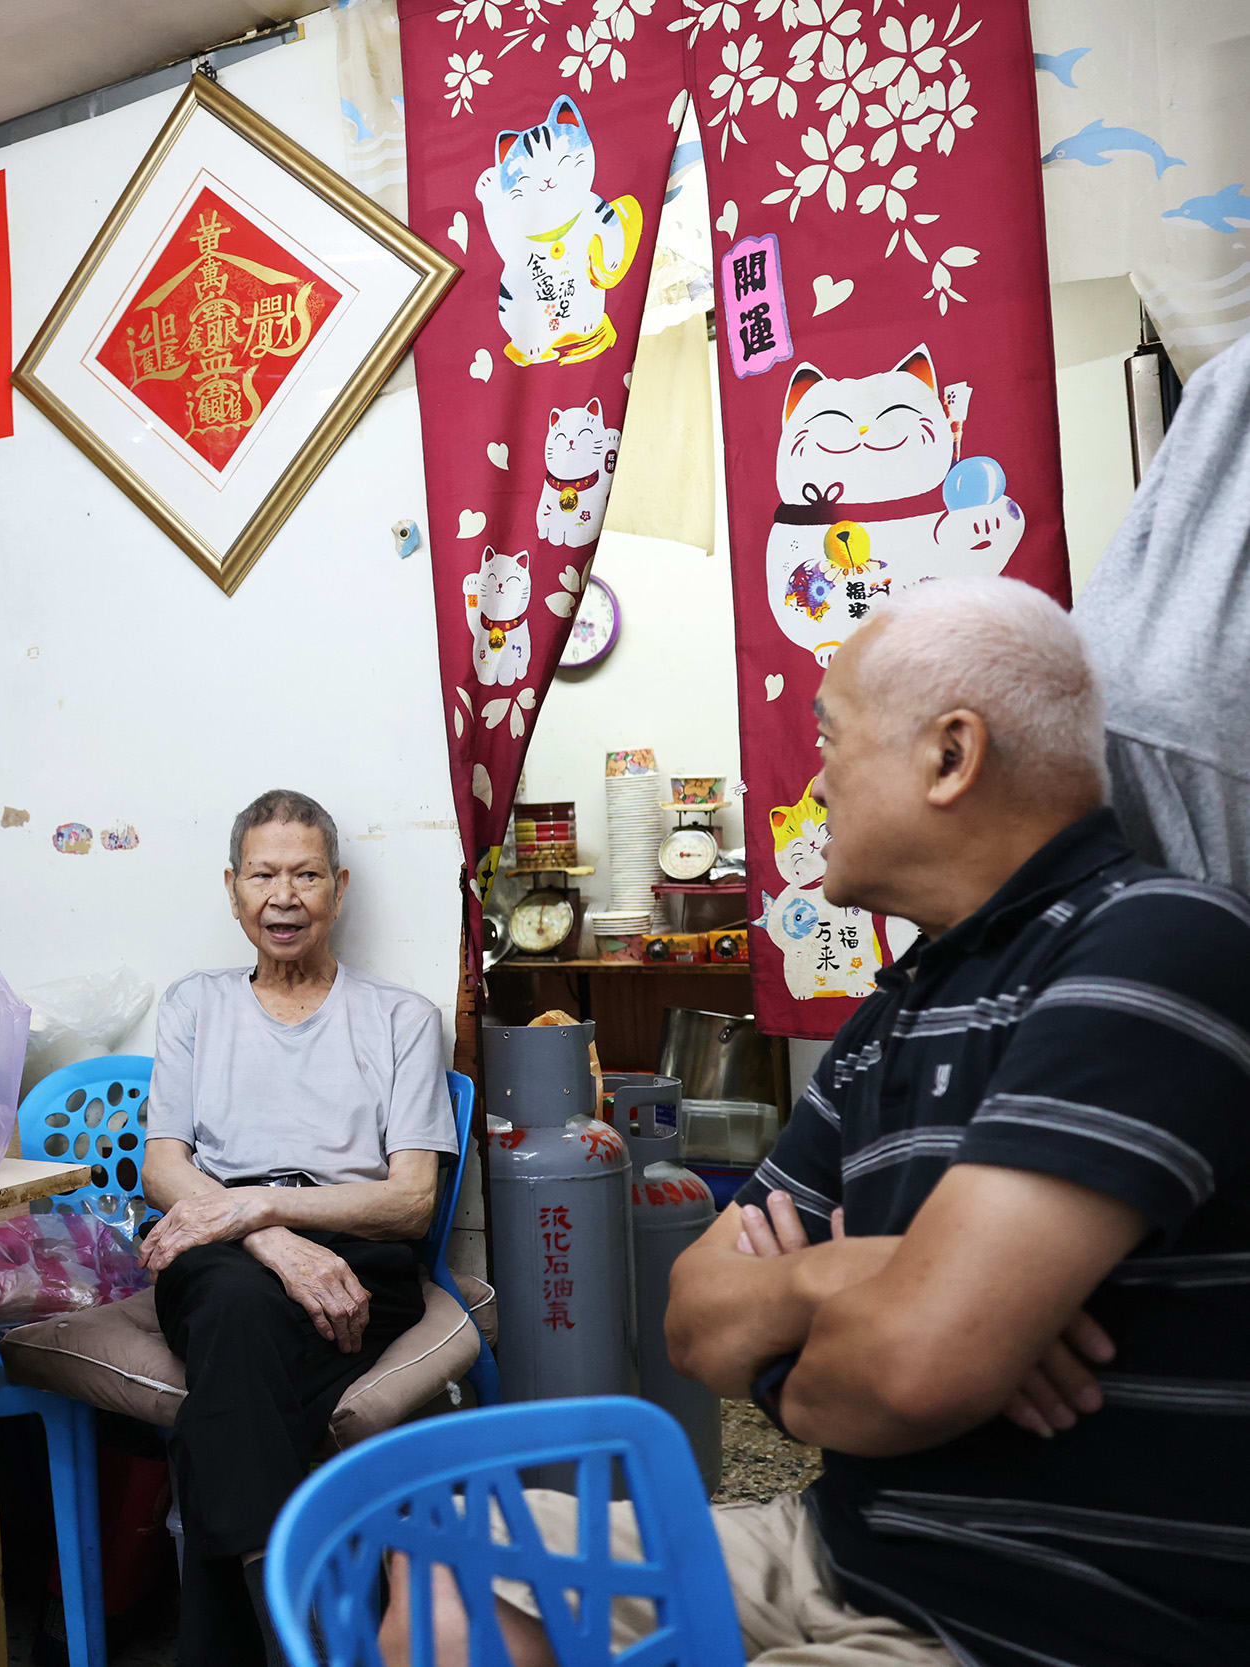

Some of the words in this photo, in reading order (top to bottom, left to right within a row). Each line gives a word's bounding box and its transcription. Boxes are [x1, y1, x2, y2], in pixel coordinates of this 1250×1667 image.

[732, 250, 776, 362] 開運
[539, 1205, 576, 1332] 液化石油氣
